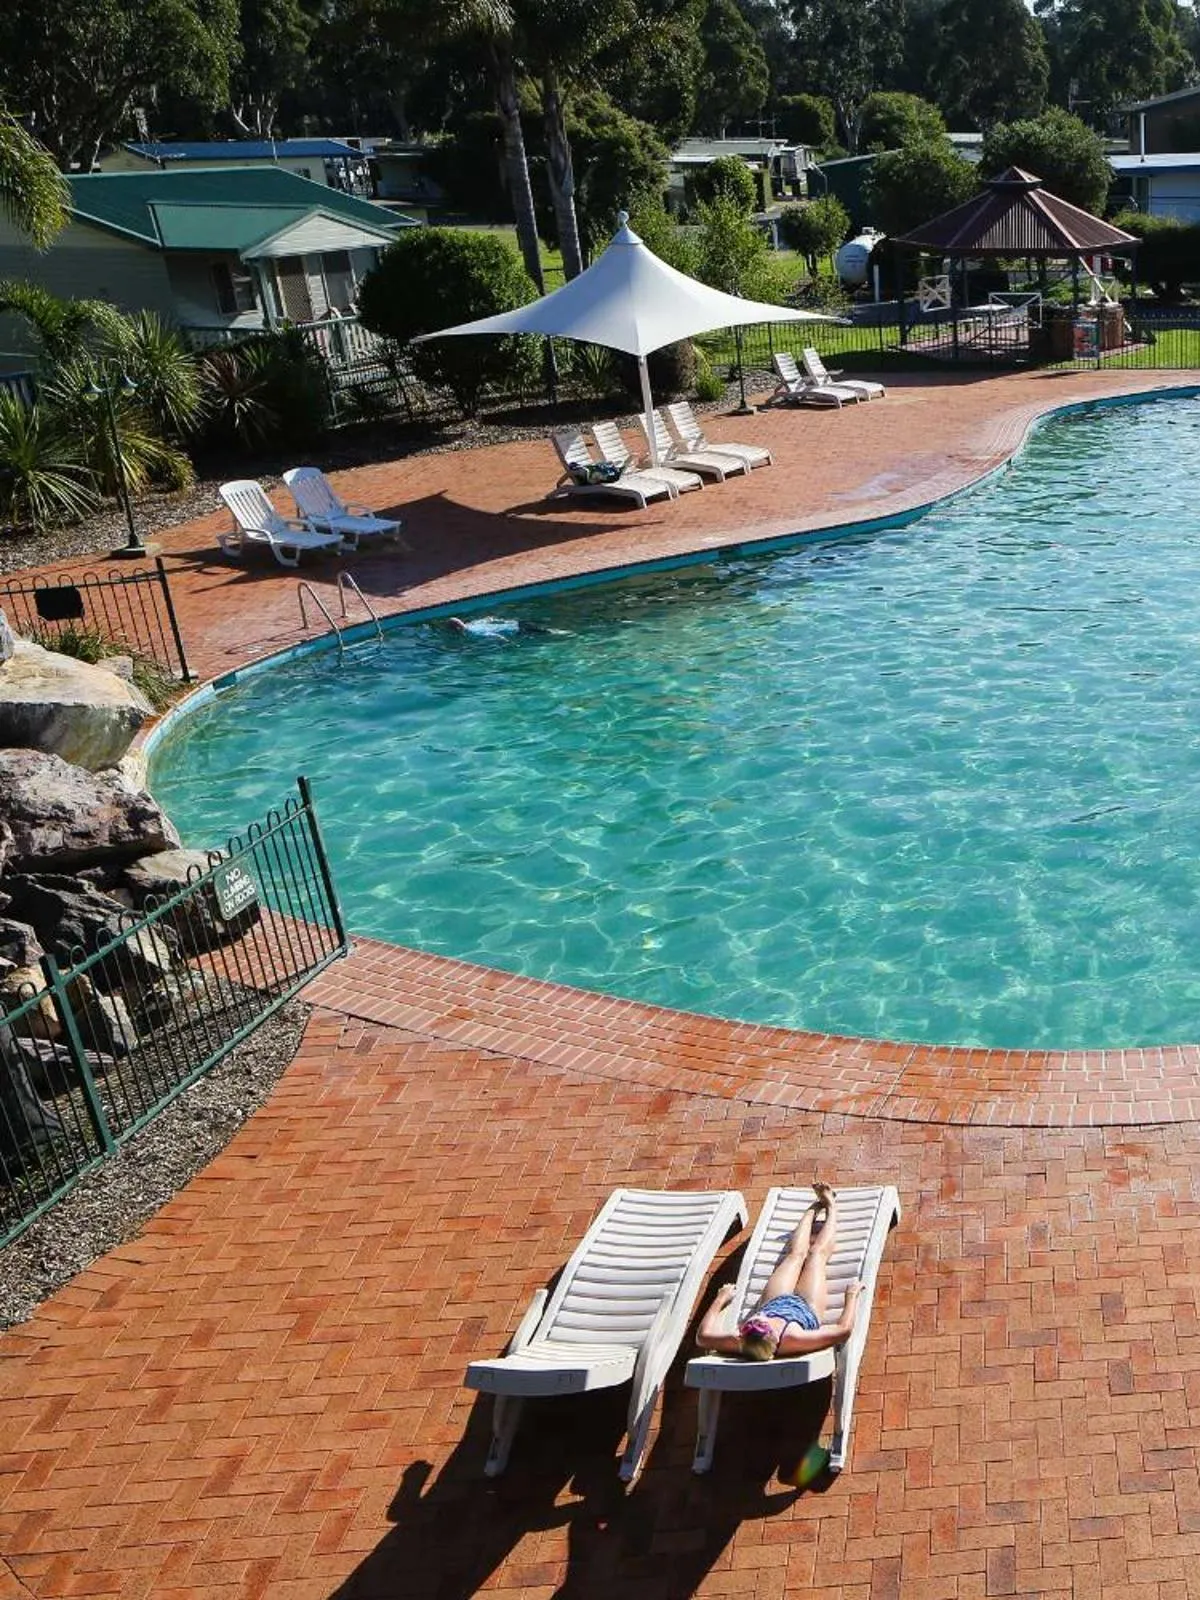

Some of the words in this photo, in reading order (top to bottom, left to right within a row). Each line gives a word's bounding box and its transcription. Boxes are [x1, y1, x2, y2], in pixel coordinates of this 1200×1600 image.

[225, 868, 240, 885] NO
[224, 899, 234, 913] ON
[234, 884, 255, 906] ROCKS
